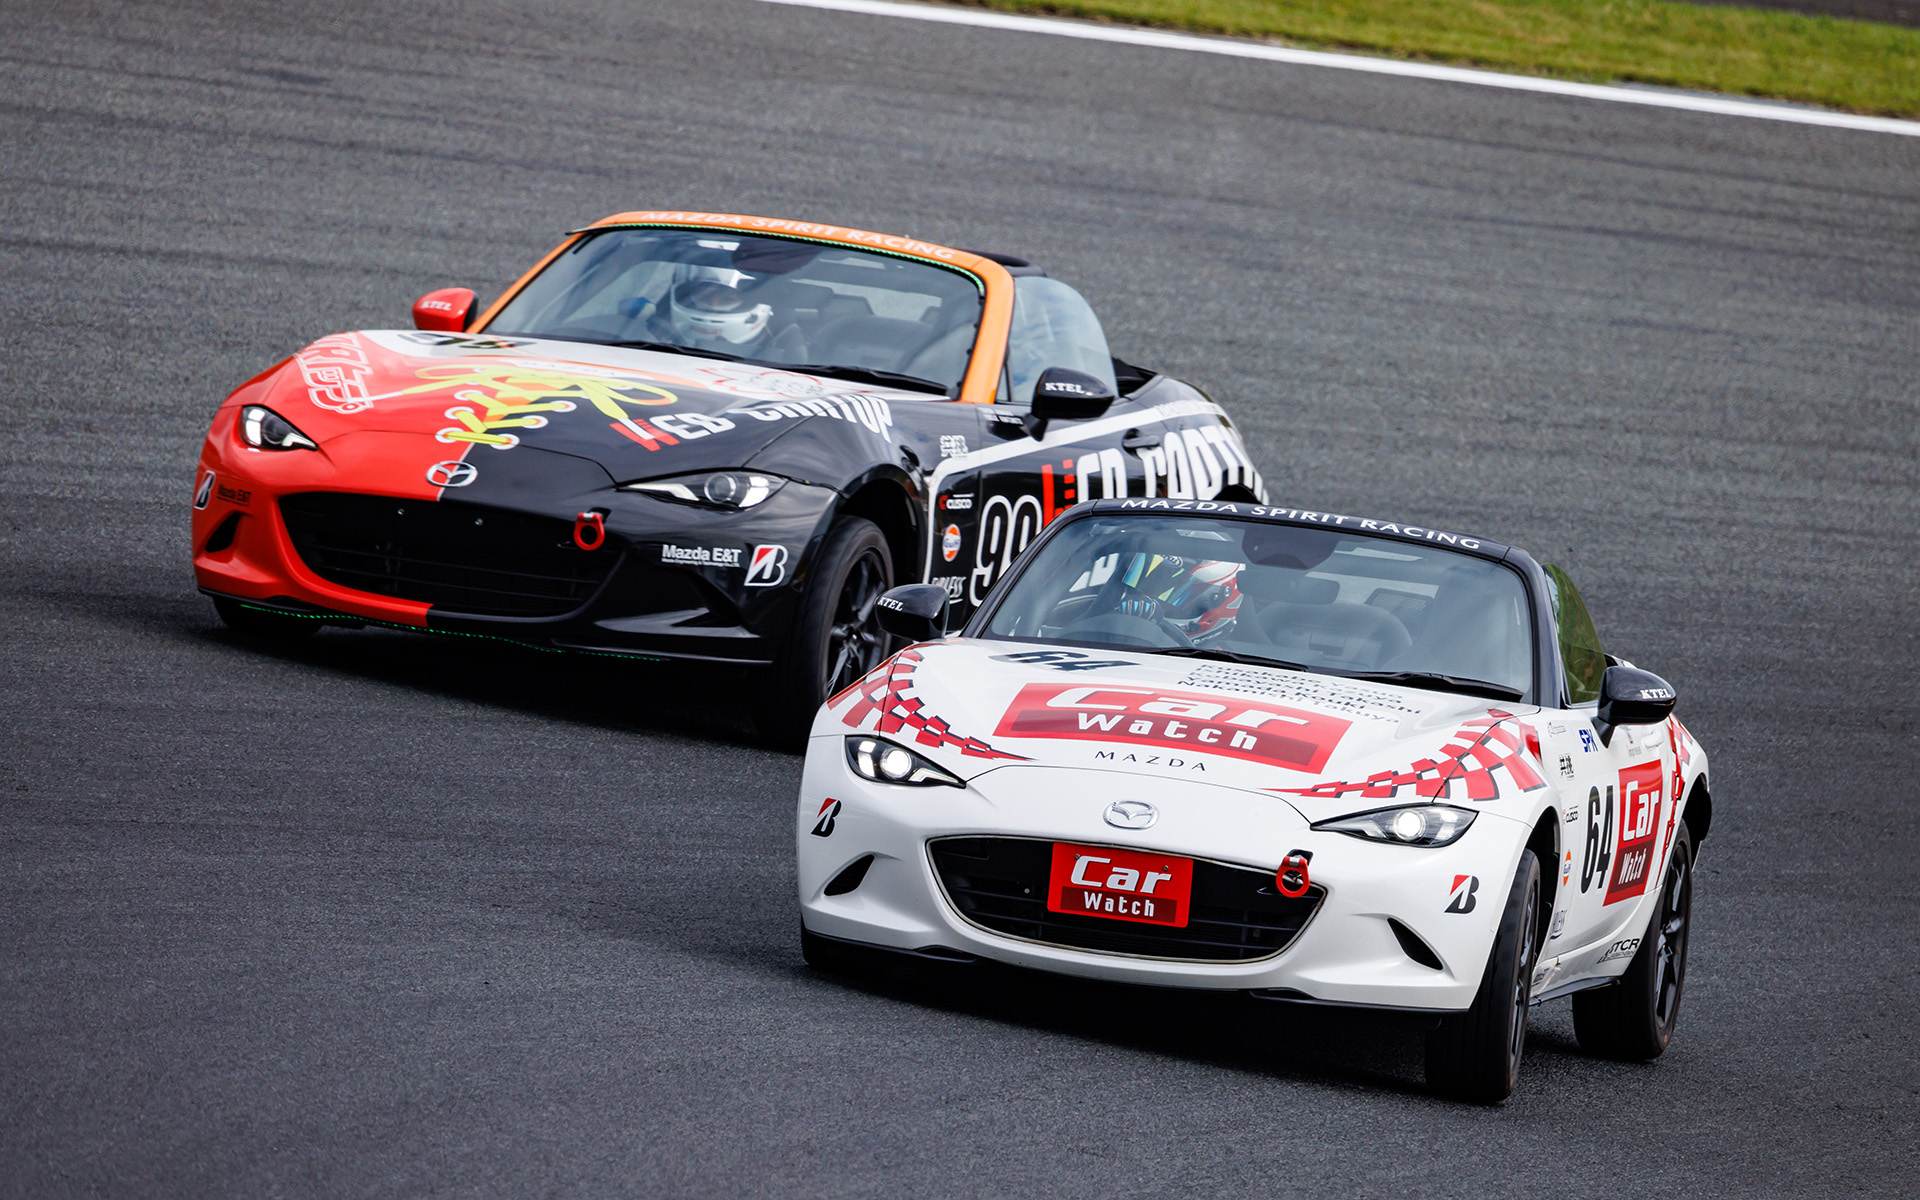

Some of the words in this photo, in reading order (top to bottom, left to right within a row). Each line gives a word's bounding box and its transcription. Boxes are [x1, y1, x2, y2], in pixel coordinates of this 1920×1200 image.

[641, 212, 742, 225] MAZDA
[751, 218, 842, 237] SPIRIT
[846, 231, 956, 260] RACING
[421, 301, 452, 311] KTEL
[1045, 382, 1085, 394] KTEL
[1120, 499, 1238, 513] MAZDA
[1250, 506, 1350, 525] SPIRIT
[1360, 518, 1481, 550] RACING
[662, 544, 711, 561] Mazda
[712, 547, 742, 563] E&T
[877, 597, 904, 612] KTEL
[988, 651, 1140, 672] 64
[1046, 686, 1311, 729] Car
[1640, 688, 1671, 699] KTEL
[1077, 711, 1258, 751] Watch
[1094, 750, 1207, 772] MAZDA
[1623, 780, 1660, 841] Car
[1580, 785, 1614, 894] 64
[1070, 855, 1172, 894] Car
[1618, 848, 1647, 885] Watch
[1083, 891, 1155, 917] Watch
